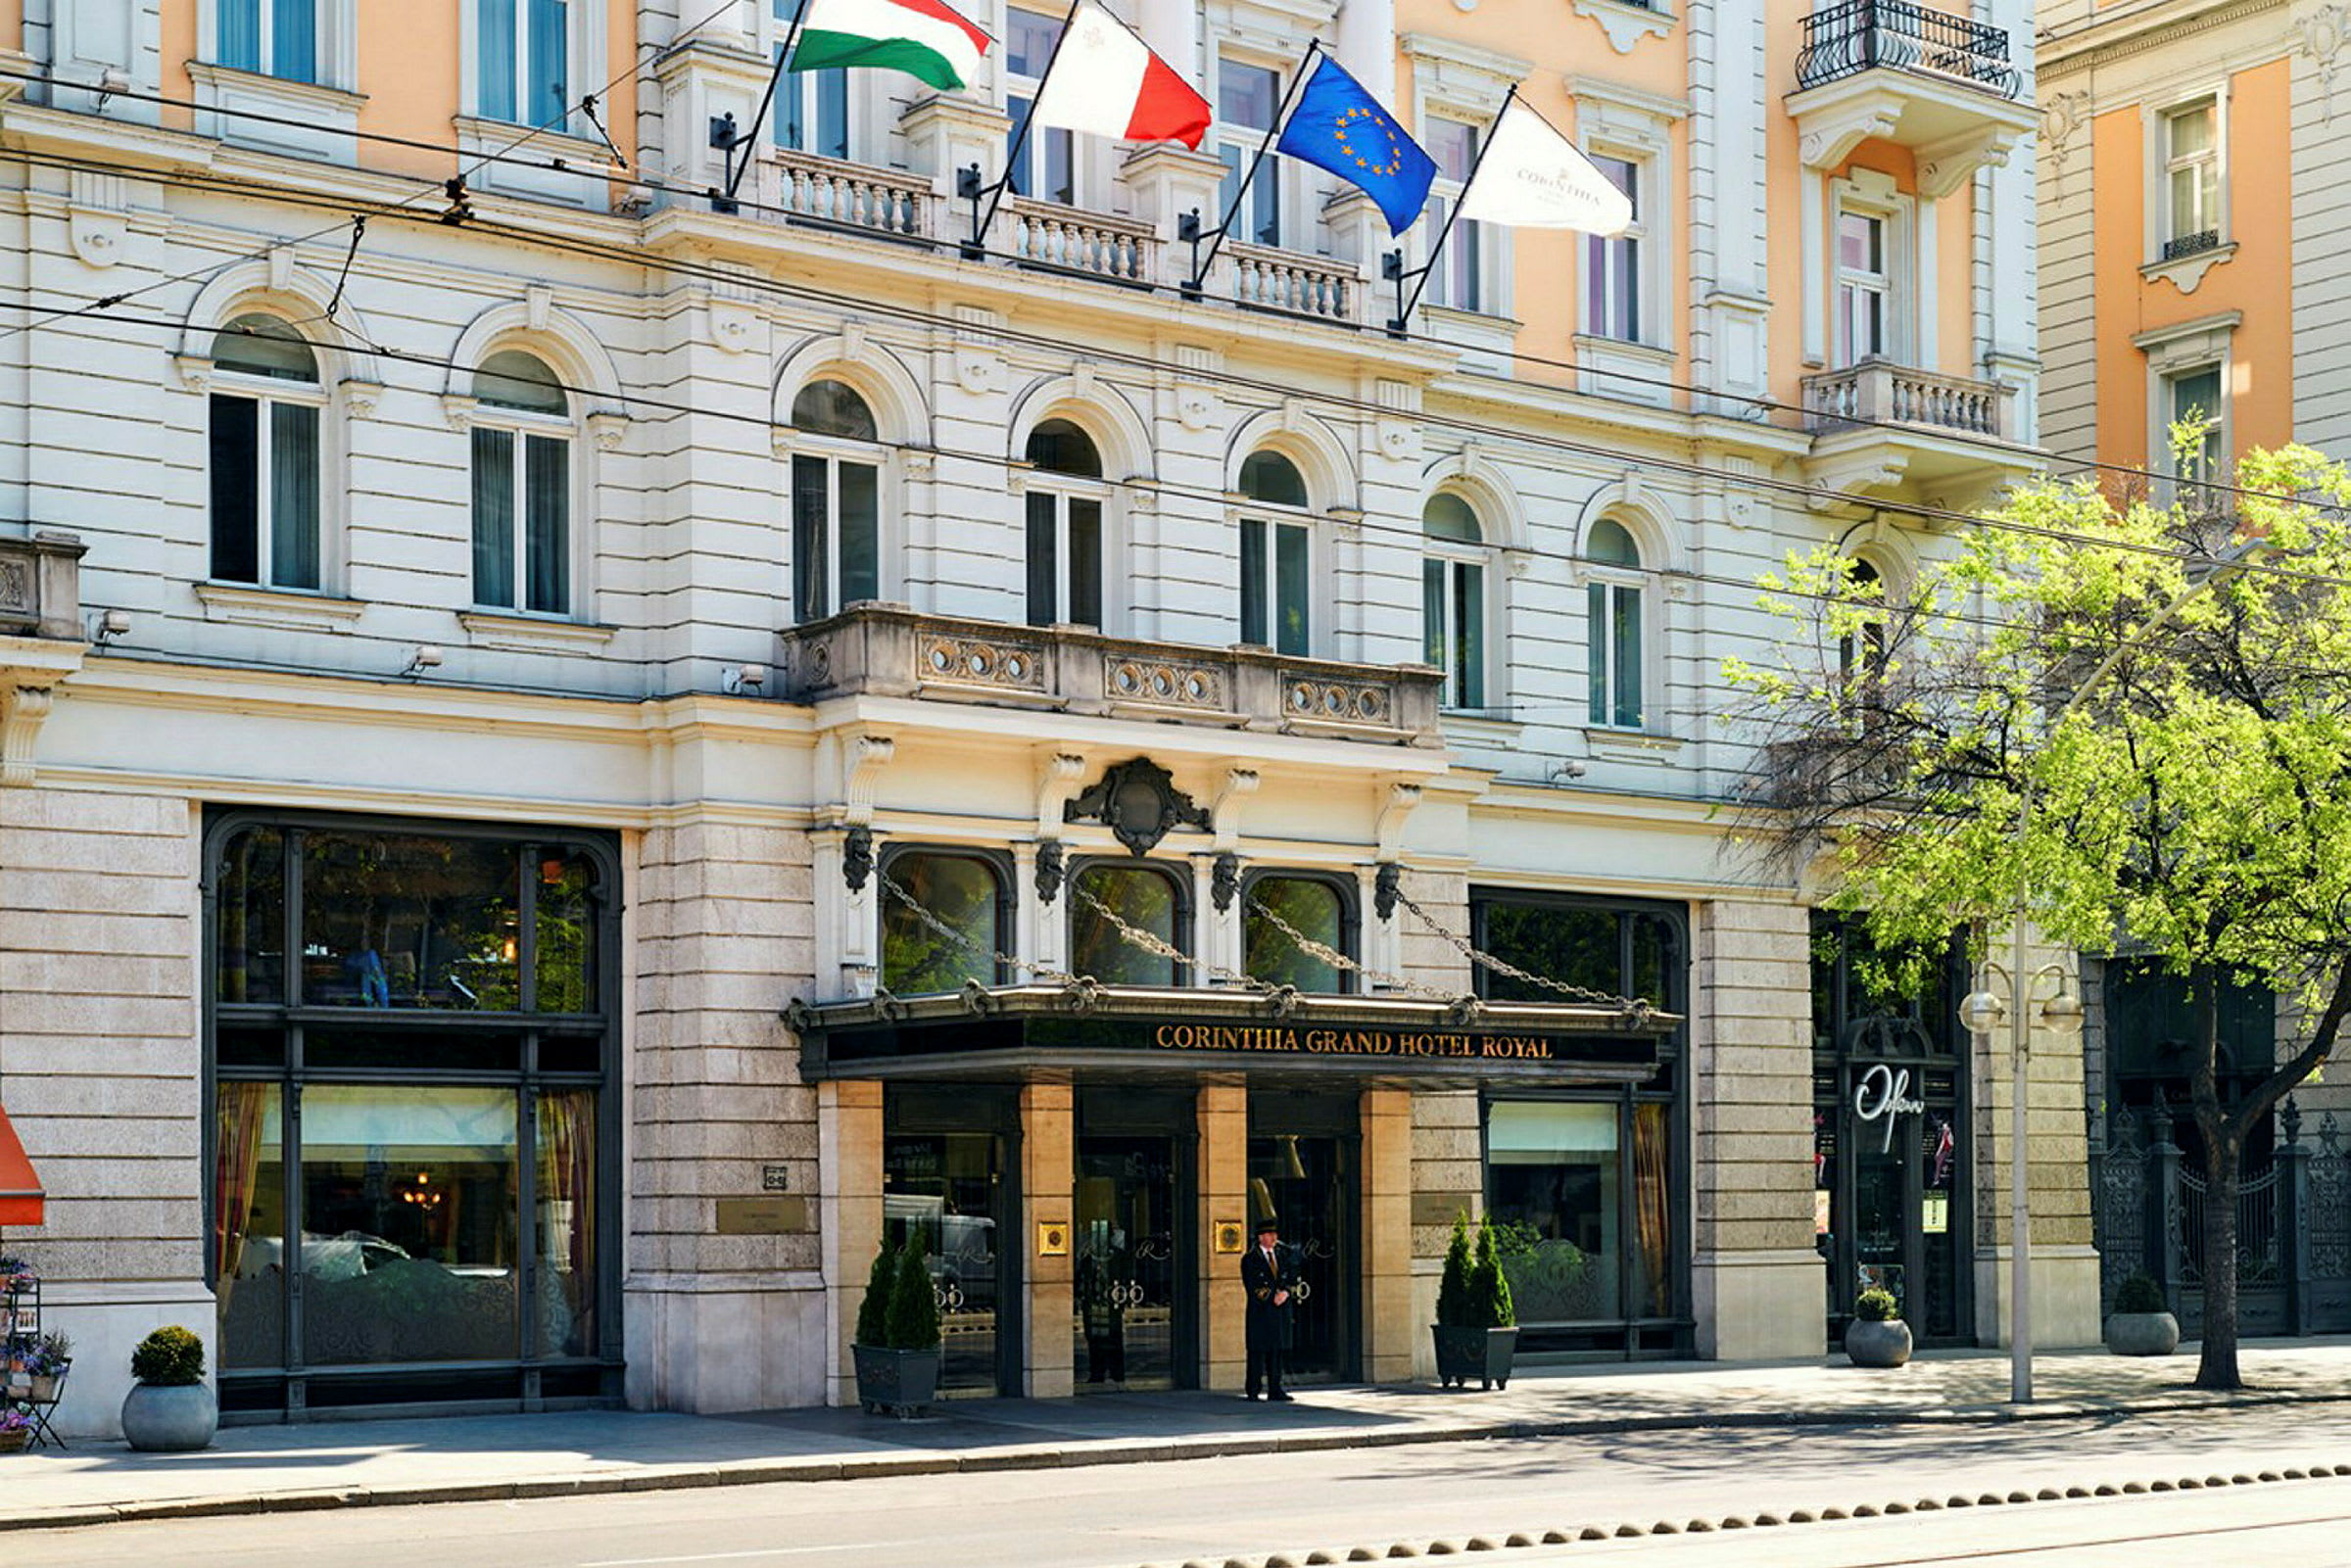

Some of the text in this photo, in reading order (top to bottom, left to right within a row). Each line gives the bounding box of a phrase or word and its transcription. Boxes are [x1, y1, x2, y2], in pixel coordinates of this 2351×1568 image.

[1157, 1025, 1554, 1059] CORINTHIA GRAND HOTEL ROYAL
